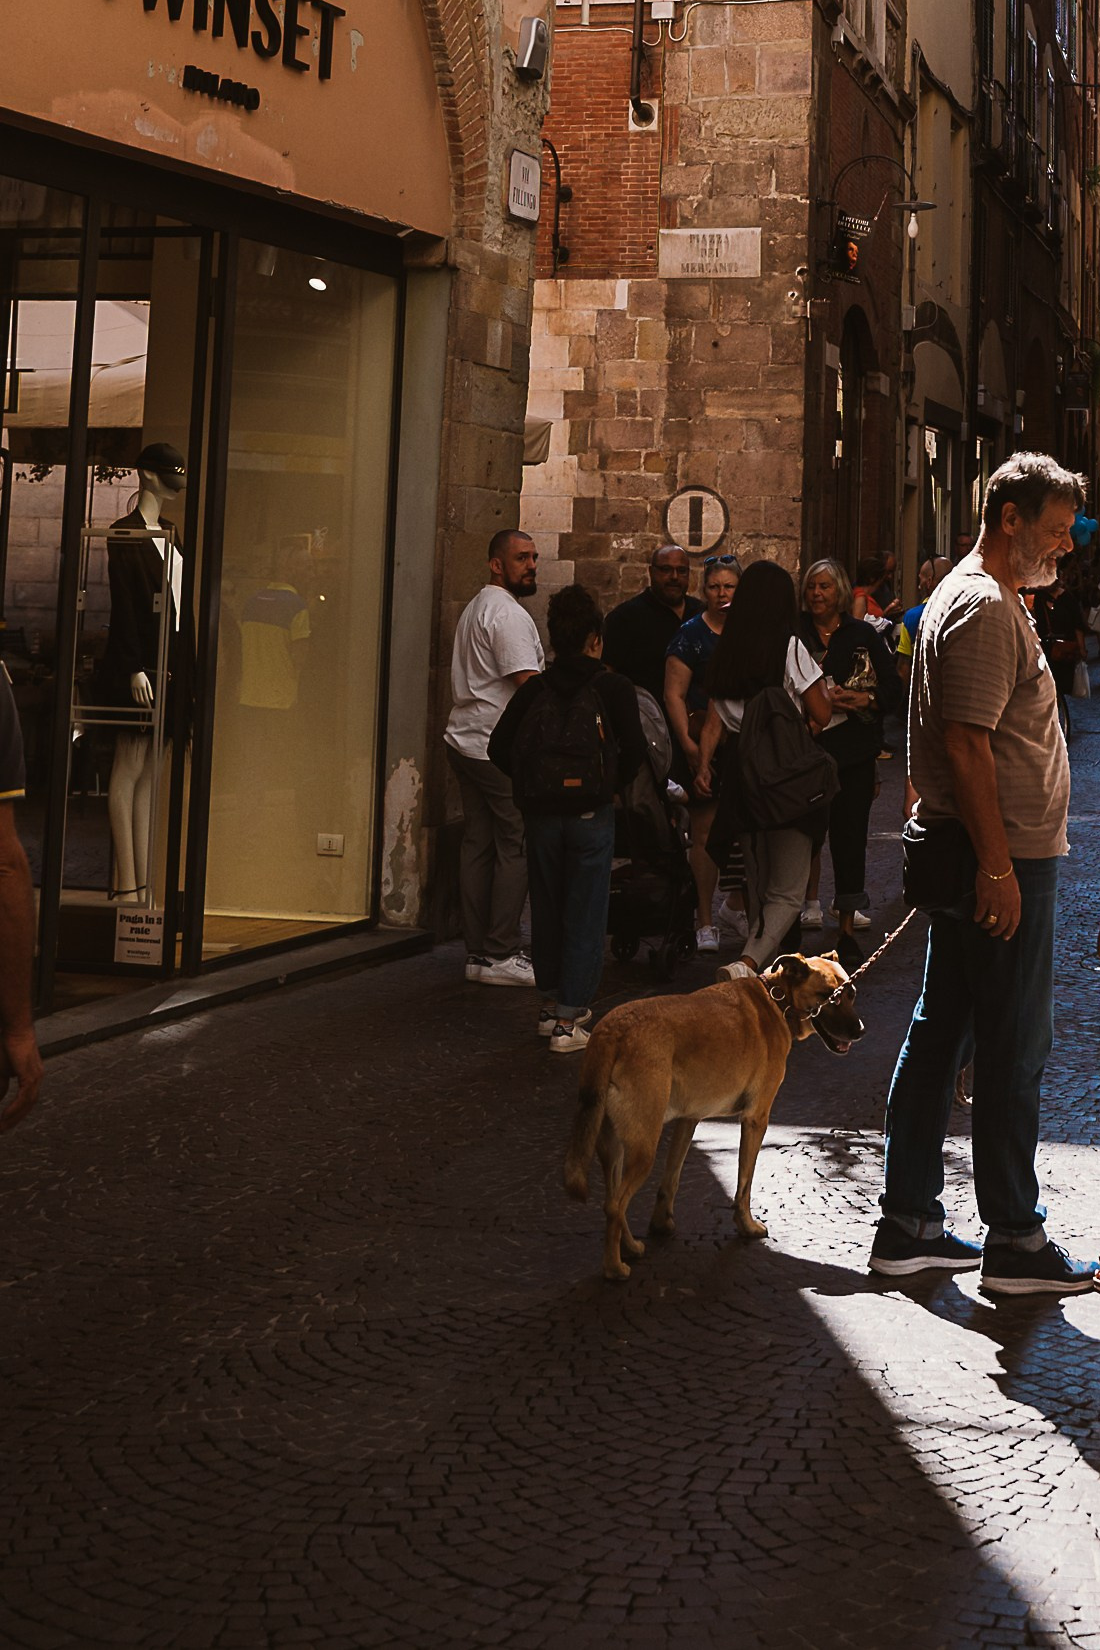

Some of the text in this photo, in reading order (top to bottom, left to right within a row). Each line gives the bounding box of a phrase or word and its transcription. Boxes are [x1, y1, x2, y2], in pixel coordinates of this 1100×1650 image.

[689, 233, 731, 247] PIAZZA
[681, 262, 739, 274] MERCANTI
[119, 914, 143, 924] Paga
[145, 915, 154, 924] in
[130, 926, 150, 935] rate
